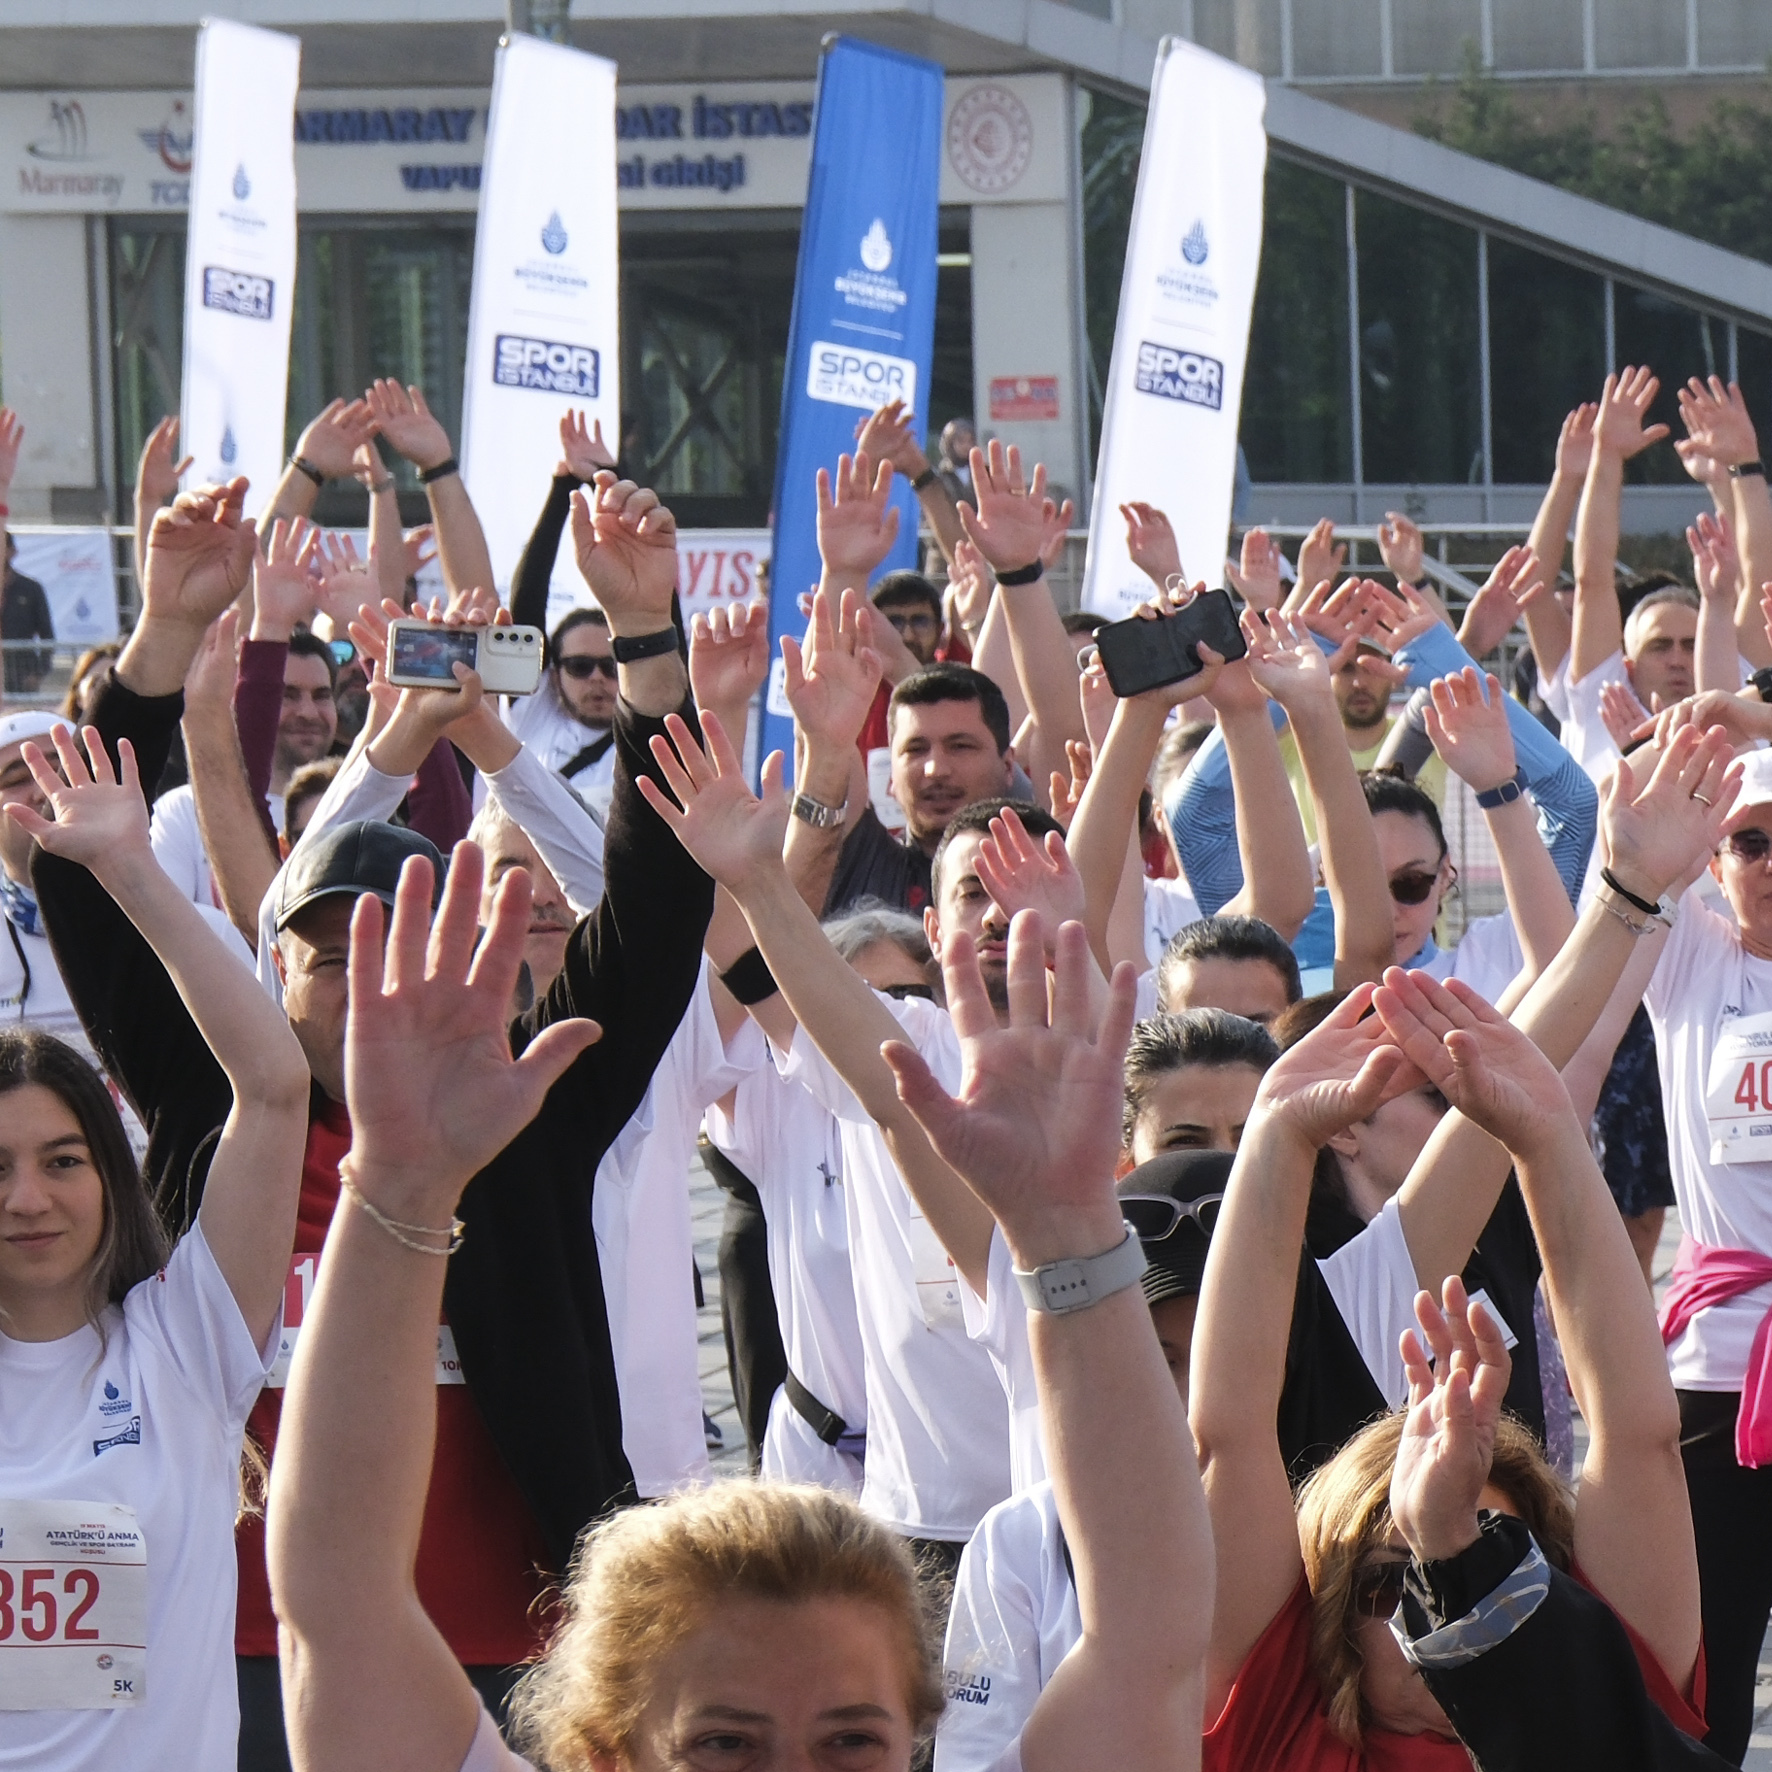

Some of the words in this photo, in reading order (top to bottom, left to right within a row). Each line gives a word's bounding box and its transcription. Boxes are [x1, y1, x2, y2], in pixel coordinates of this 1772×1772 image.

[19, 167, 125, 206] Marmaray
[500, 338, 597, 377] SPOR
[820, 352, 905, 392] SPOR
[1139, 343, 1221, 390] SPOR
[46, 1529, 105, 1541] ATATÜRK'Ü
[109, 1532, 139, 1541] ANMA
[114, 1680, 134, 1694] 5K
